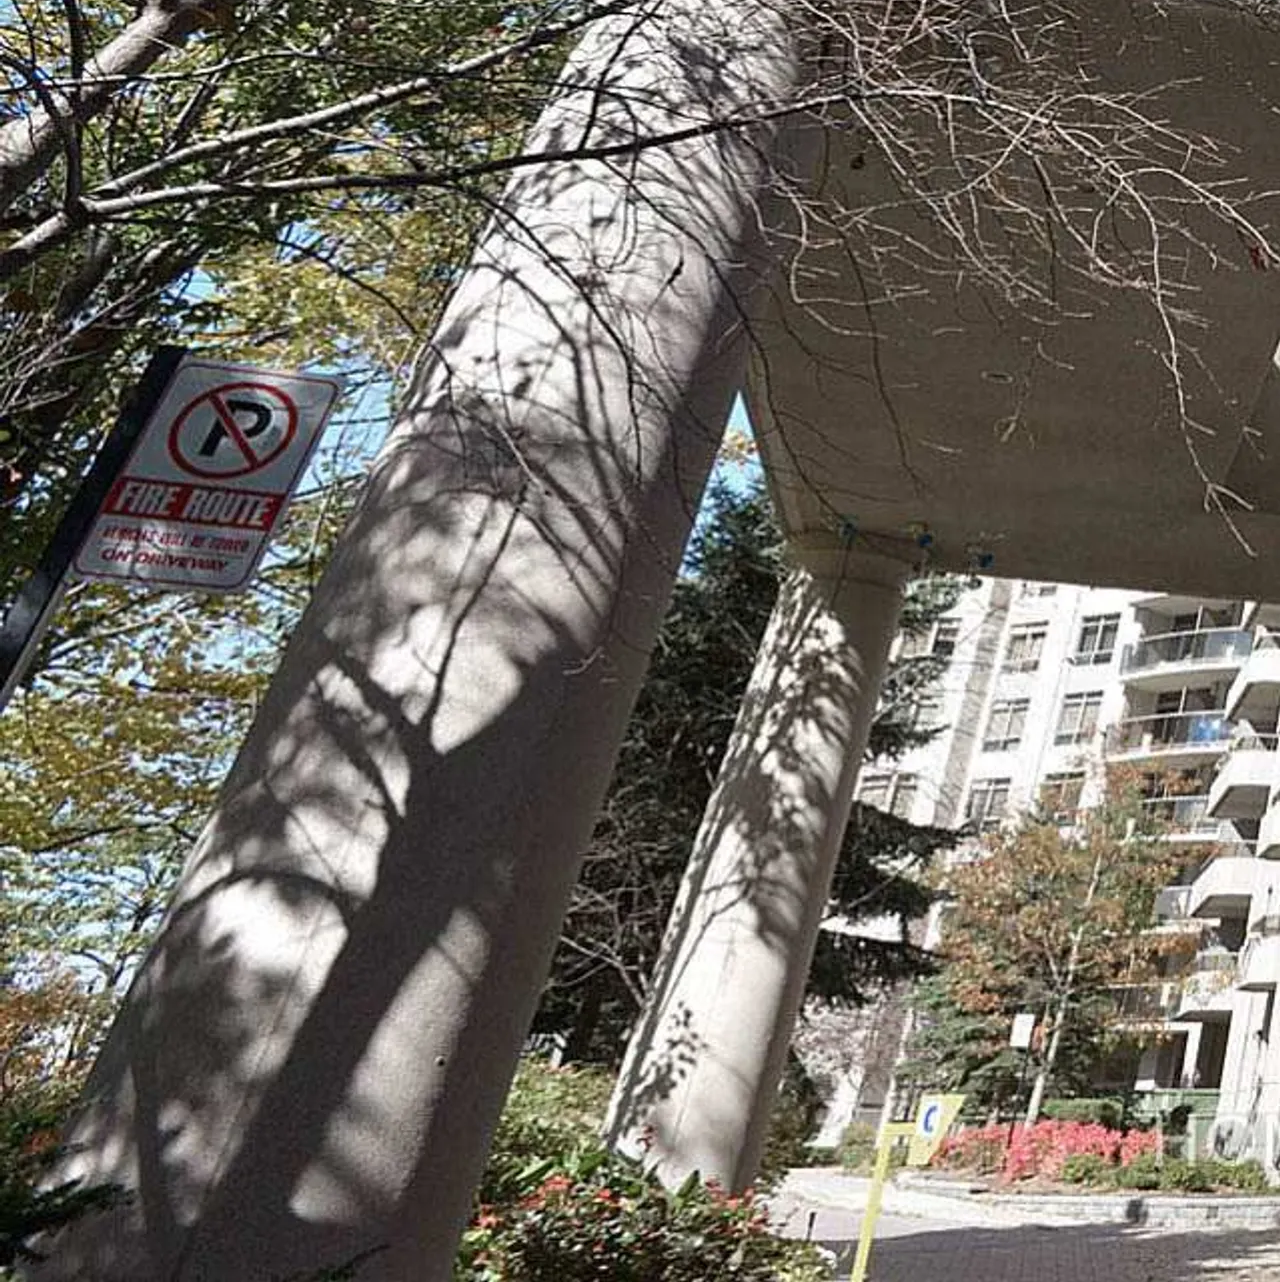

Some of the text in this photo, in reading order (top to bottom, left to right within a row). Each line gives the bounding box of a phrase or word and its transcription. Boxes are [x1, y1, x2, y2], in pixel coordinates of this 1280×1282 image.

[114, 481, 271, 527] FIRE ROUTE
[101, 547, 131, 563] ON
